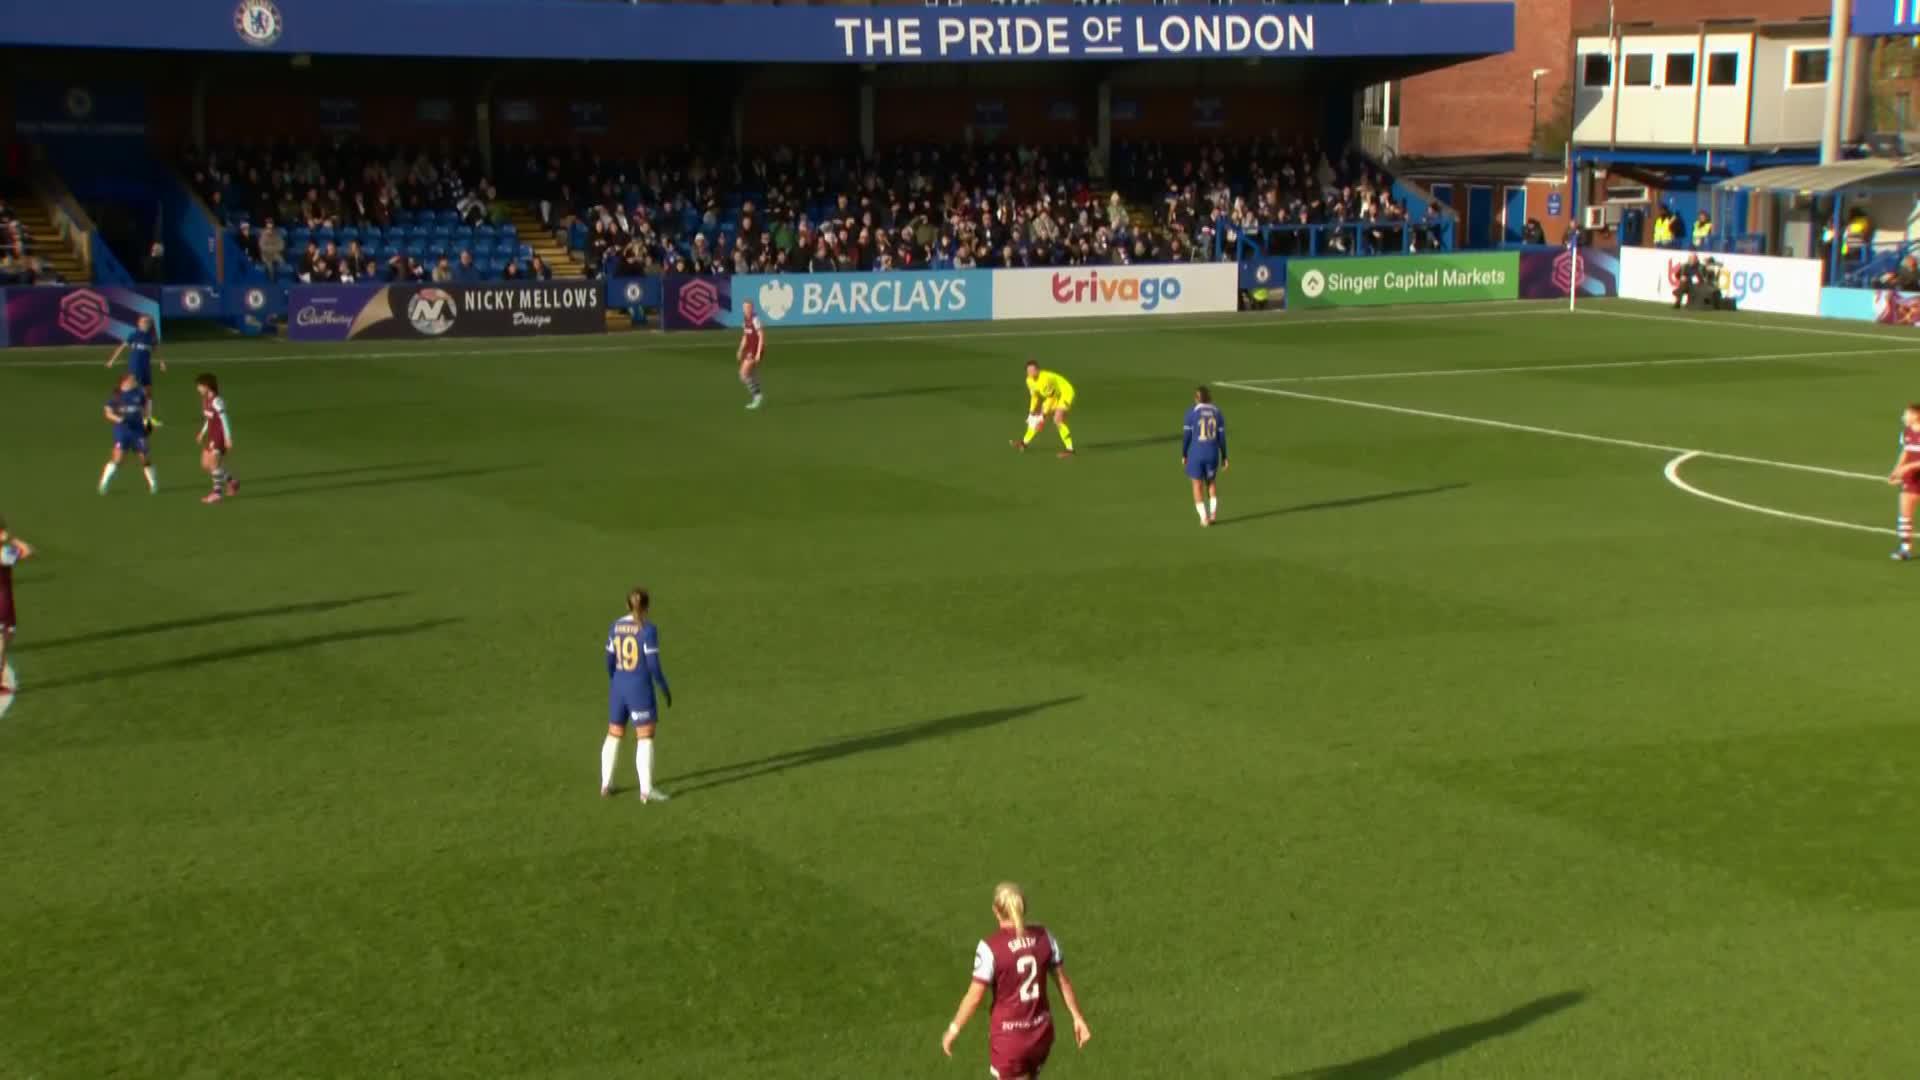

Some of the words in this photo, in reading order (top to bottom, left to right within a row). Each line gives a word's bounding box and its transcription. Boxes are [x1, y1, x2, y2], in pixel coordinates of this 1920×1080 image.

[835, 18, 921, 56] THE
[938, 17, 1070, 55] PRIDE
[1082, 16, 1123, 42] OF
[1135, 14, 1315, 53] LONDON
[802, 278, 967, 316] BARCLAYS
[1051, 271, 1182, 311] trivago
[1327, 272, 1379, 295] Singer
[1383, 268, 1439, 294] Capital
[1442, 267, 1505, 287] Markets
[464, 290, 515, 312] NICKY
[519, 287, 598, 310] MELLOWS
[512, 311, 552, 328] Design
[1198, 416, 1217, 442] 10
[613, 635, 639, 671] 19
[1016, 954, 1040, 1003] 2
